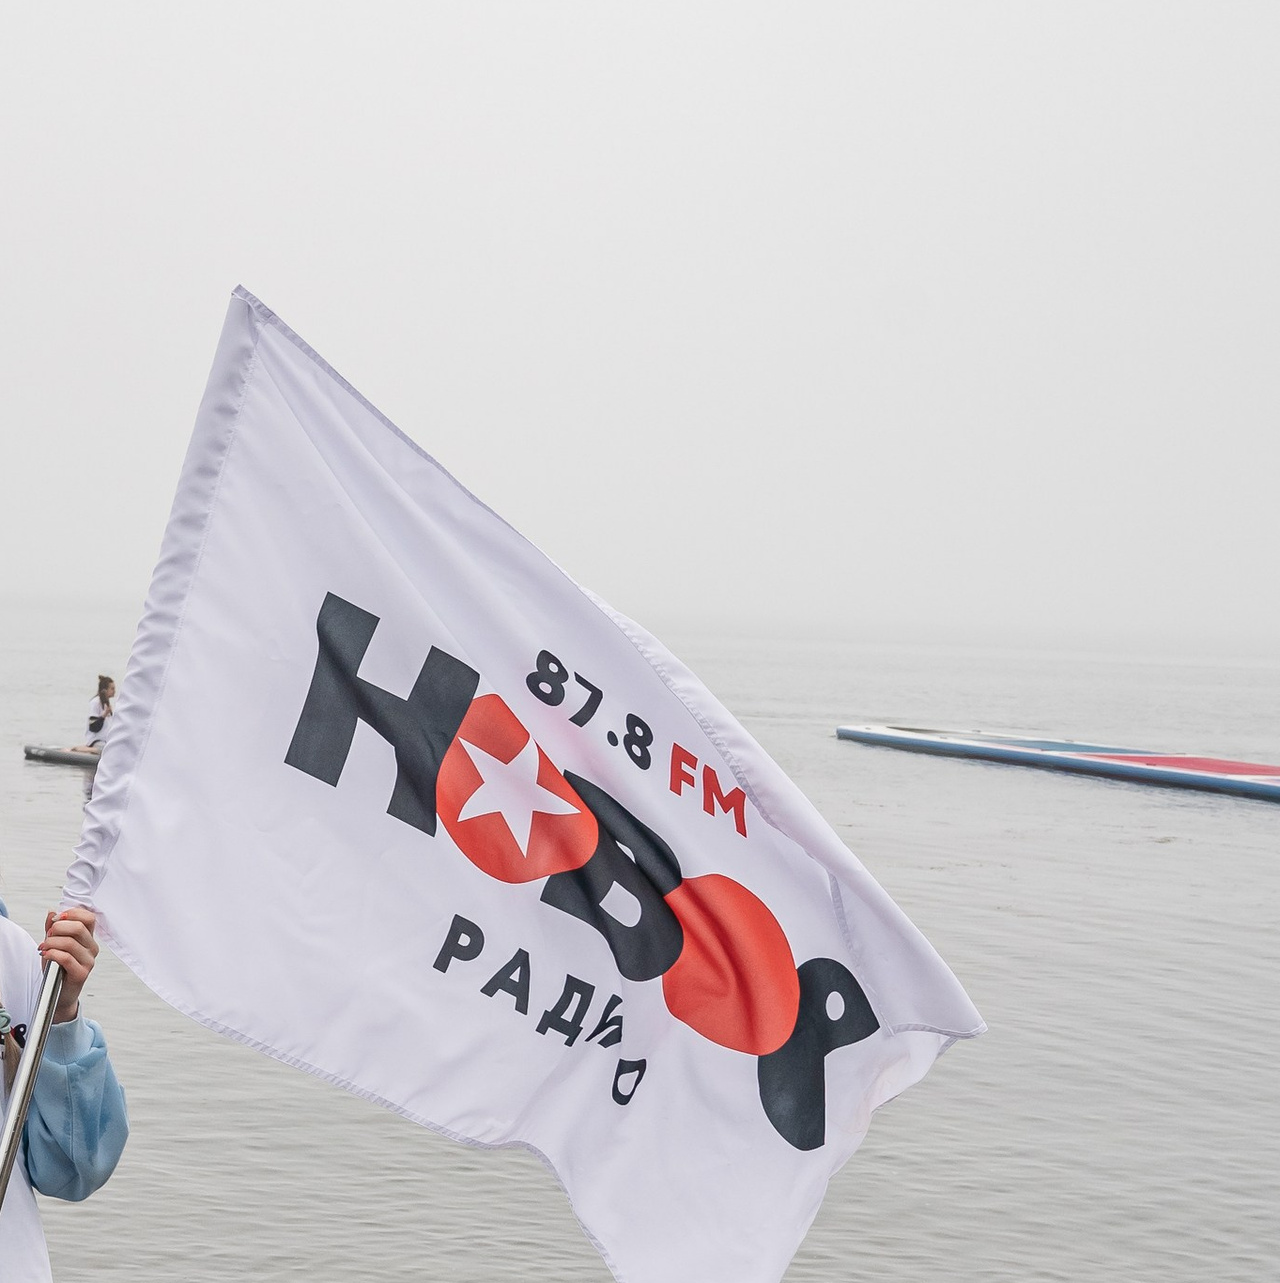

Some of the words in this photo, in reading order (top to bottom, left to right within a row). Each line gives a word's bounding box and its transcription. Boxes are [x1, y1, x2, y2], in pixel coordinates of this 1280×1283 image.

[526, 649, 653, 771] 87.8
[670, 742, 747, 838] FM
[432, 913, 647, 1106] РАДИО
